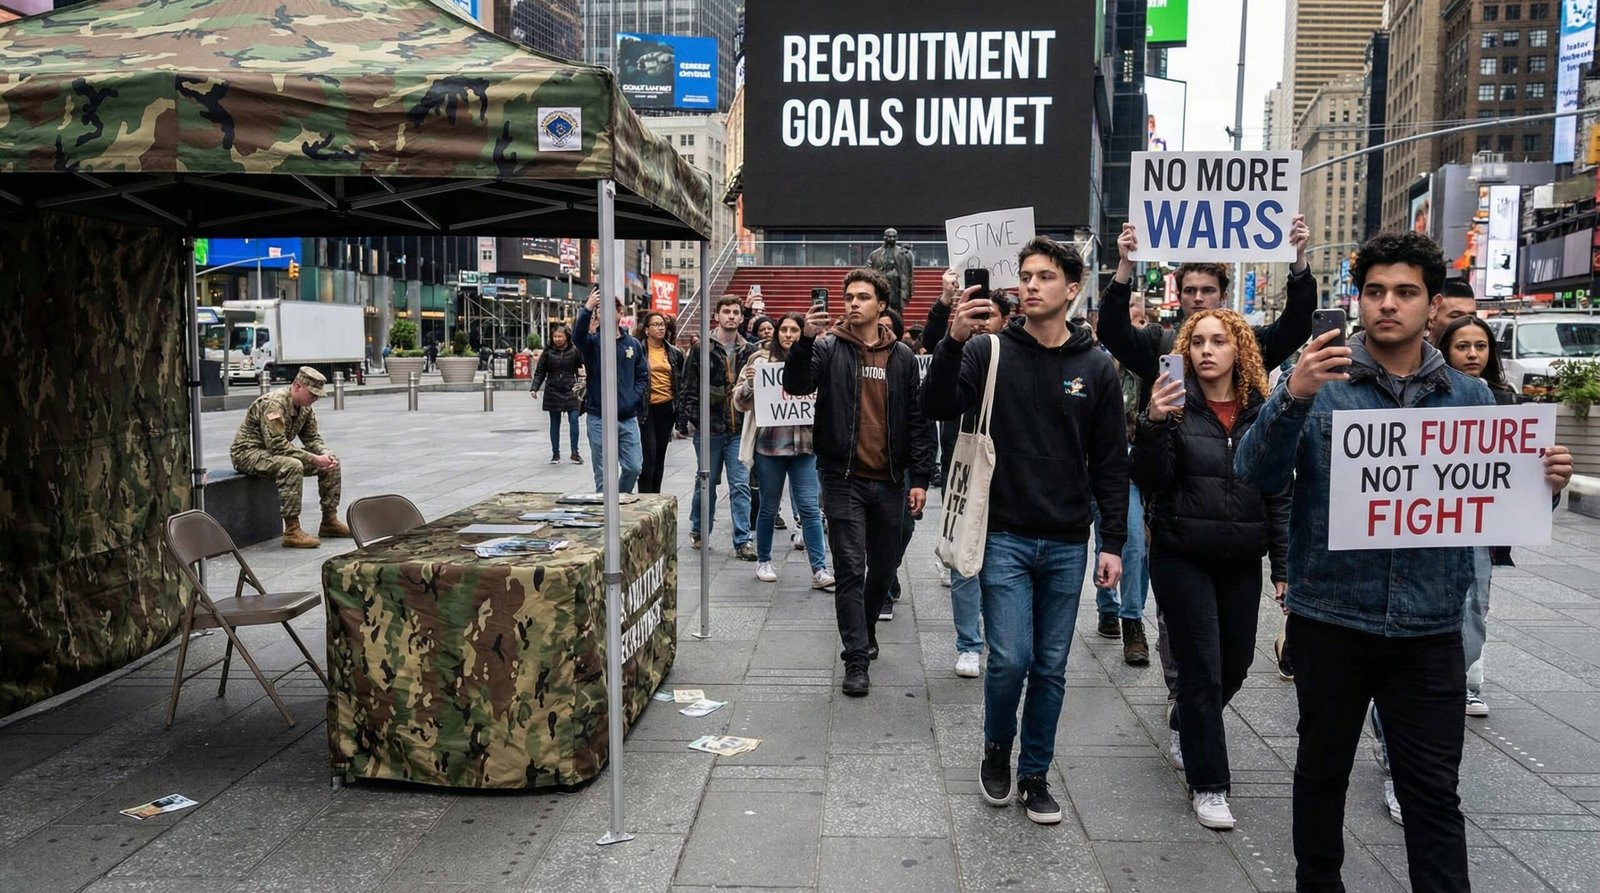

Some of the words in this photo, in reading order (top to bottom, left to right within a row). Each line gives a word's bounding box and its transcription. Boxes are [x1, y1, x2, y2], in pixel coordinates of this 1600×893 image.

[783, 30, 1056, 82] RECRUITMENT
[781, 98, 904, 147] GOALS
[915, 96, 1053, 146] UNMET
[1144, 158, 1186, 192] NO
[1197, 158, 1289, 192] MORE
[1144, 199, 1284, 250] WARS
[1343, 421, 1407, 459] OUR
[1420, 418, 1546, 459] FUTURE,
[1361, 464, 1419, 493] NOT
[1433, 462, 1512, 491] YOUR
[1367, 496, 1495, 537] FIGHT
